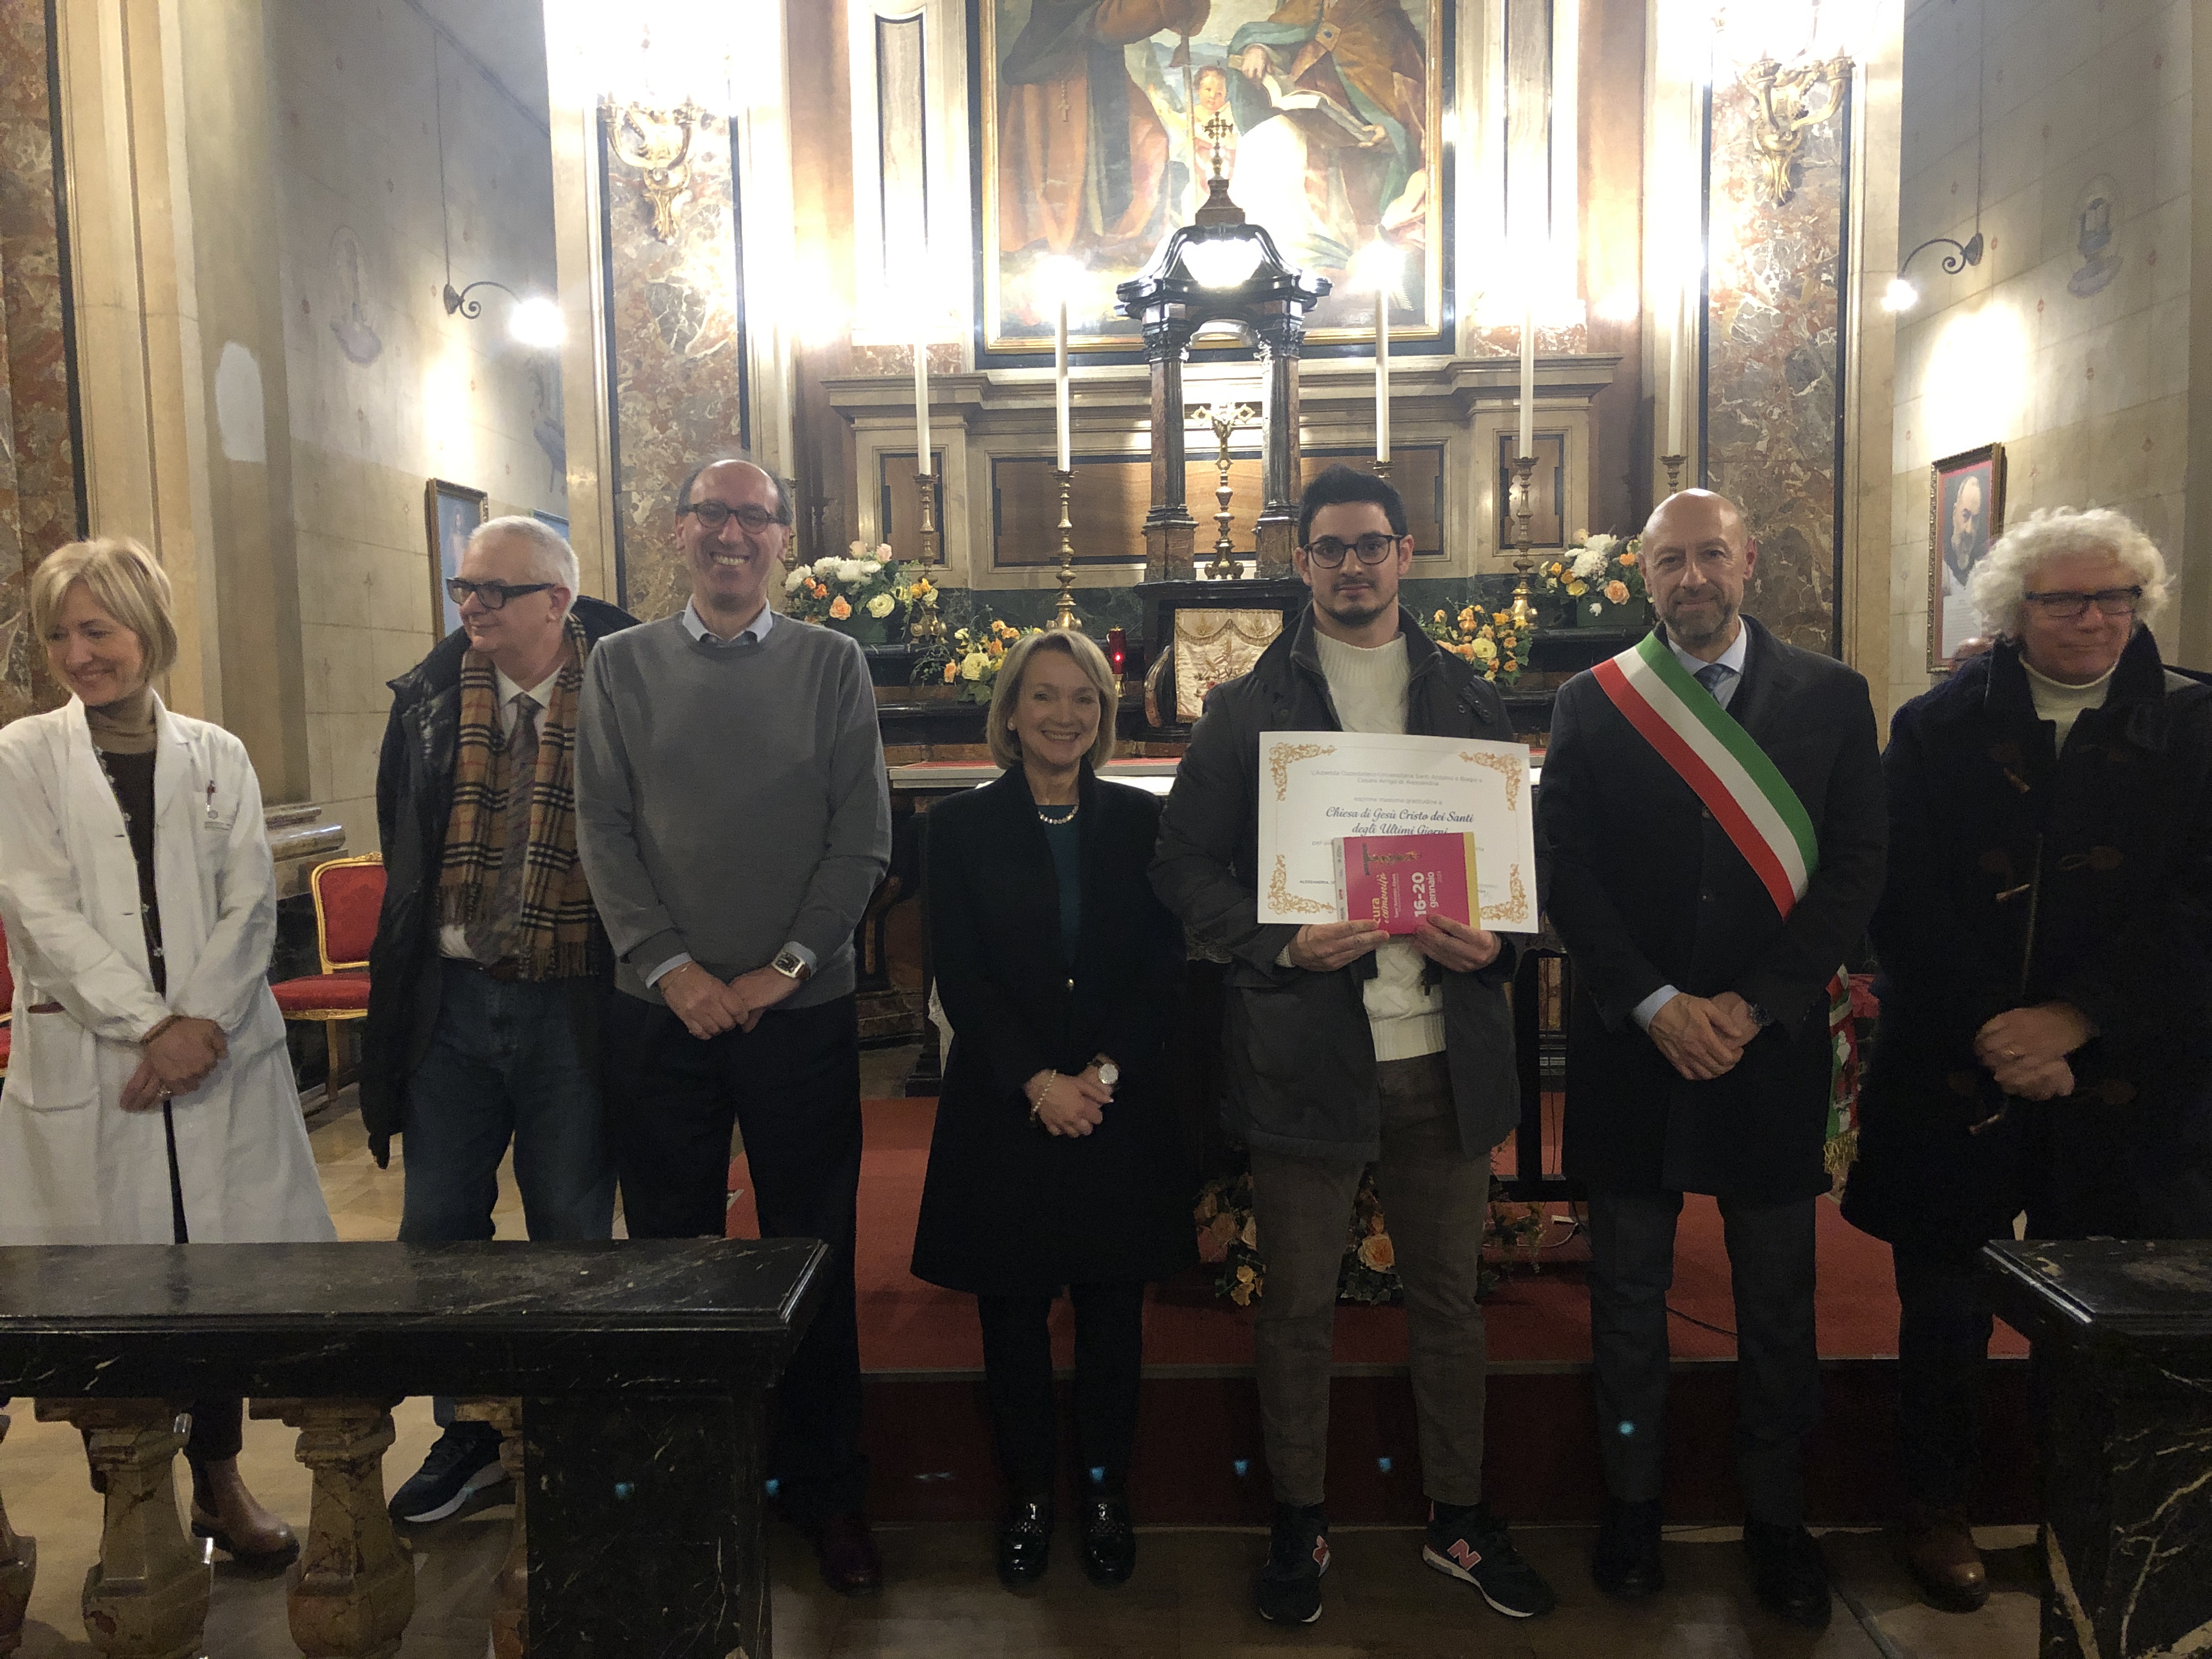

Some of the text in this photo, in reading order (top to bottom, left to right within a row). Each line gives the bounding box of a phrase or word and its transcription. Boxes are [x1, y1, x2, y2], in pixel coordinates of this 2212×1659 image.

[1326, 806, 1474, 823] Chiesa di Gesù Cristo dei Santi
[1352, 823, 1377, 837] degli
[1380, 823, 1415, 834] Ultimi
[1376, 872, 1389, 919] comunità
[1412, 872, 1427, 917] 16-20
[1426, 871, 1440, 908] gennaio
[1447, 1538, 1482, 1571] N
